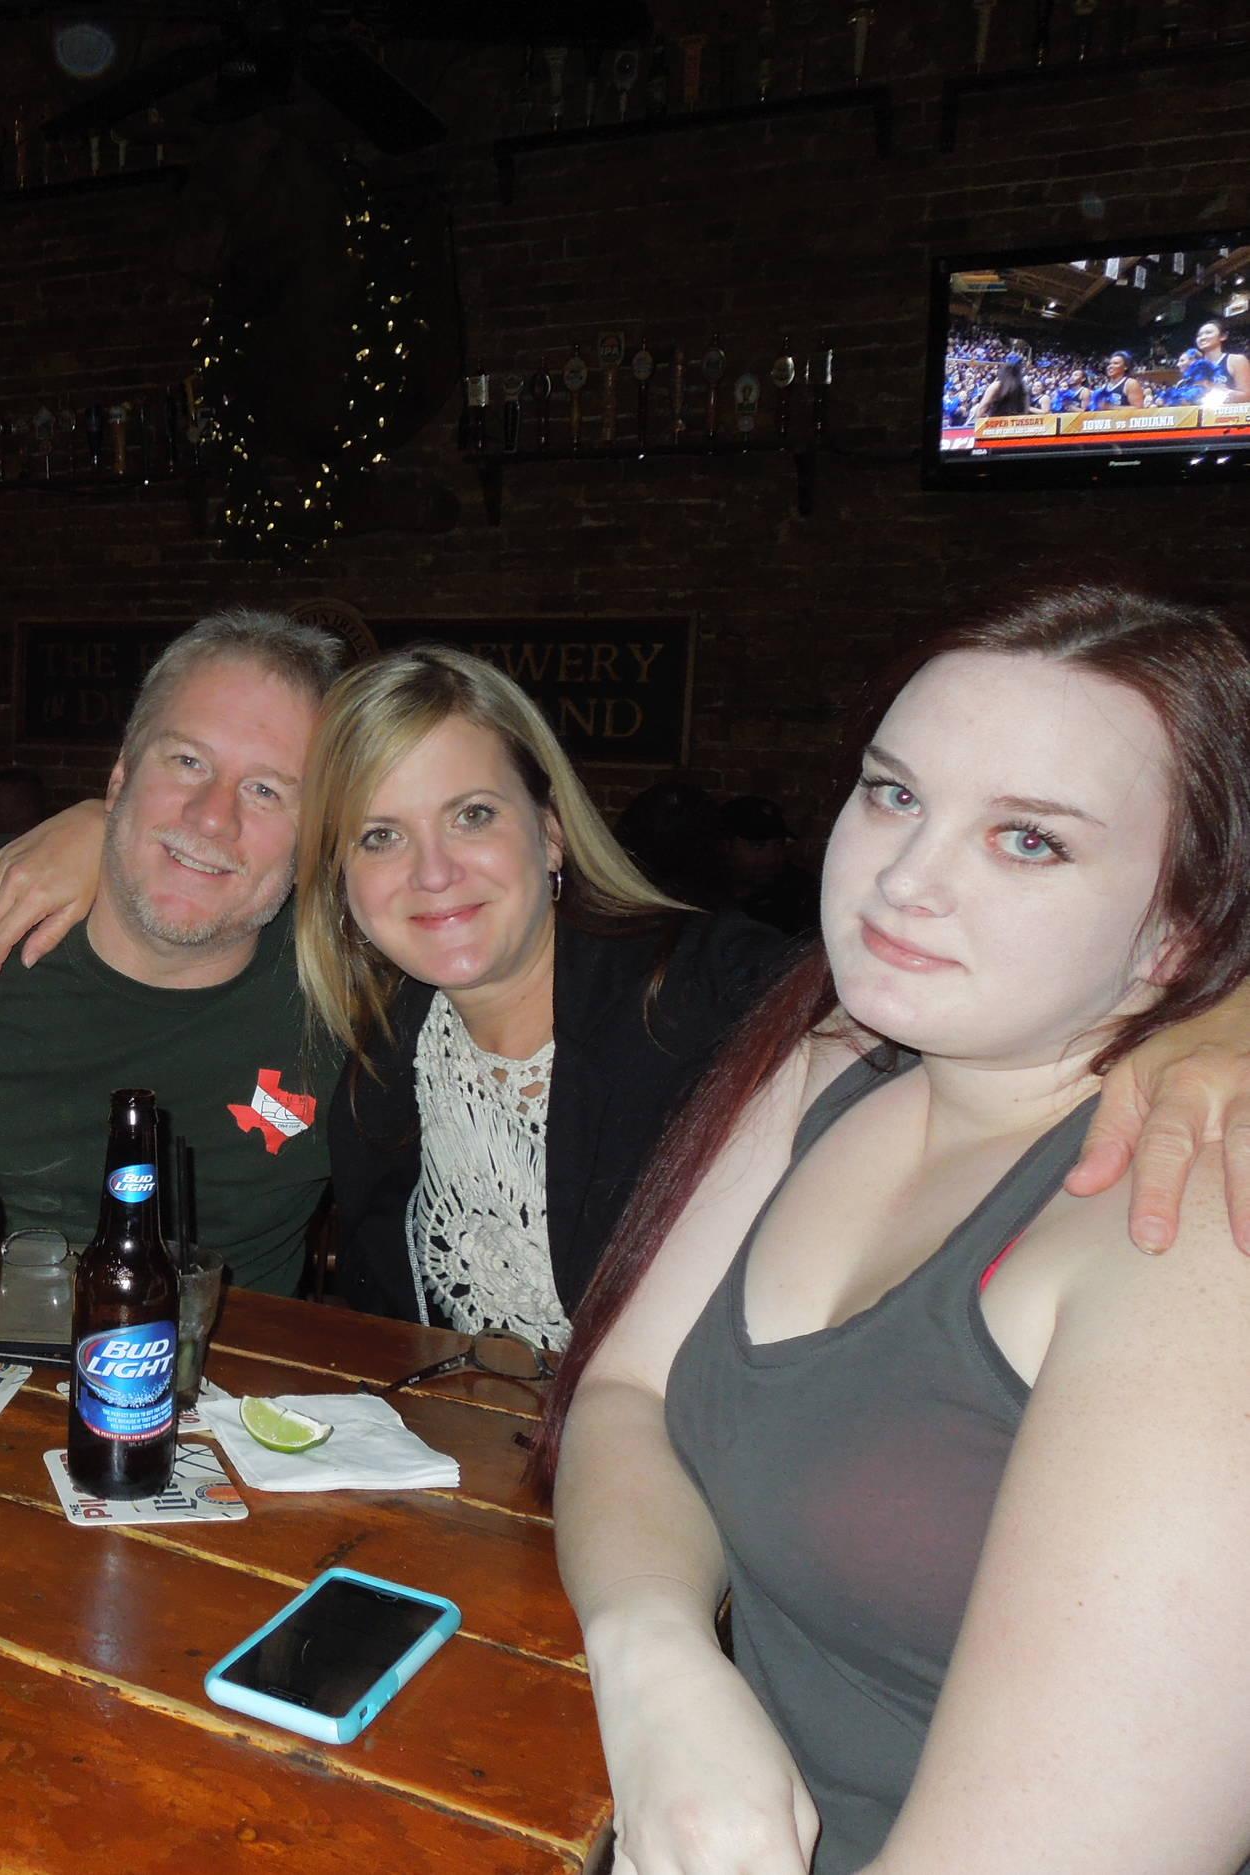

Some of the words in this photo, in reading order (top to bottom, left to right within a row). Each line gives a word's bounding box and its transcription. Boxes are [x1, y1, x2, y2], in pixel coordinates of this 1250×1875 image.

[1011, 417, 1045, 426] TUESDAY
[1082, 419, 1112, 431] IOWA
[1129, 415, 1175, 428] INDIANA
[470, 640, 665, 684] EWERY
[556, 696, 645, 737] ND
[122, 1173, 153, 1183] BUD
[114, 1181, 156, 1192] LIGHT
[101, 1338, 170, 1359] BUD
[86, 1353, 174, 1379] LIGHT
[69, 1503, 82, 1517] THE
